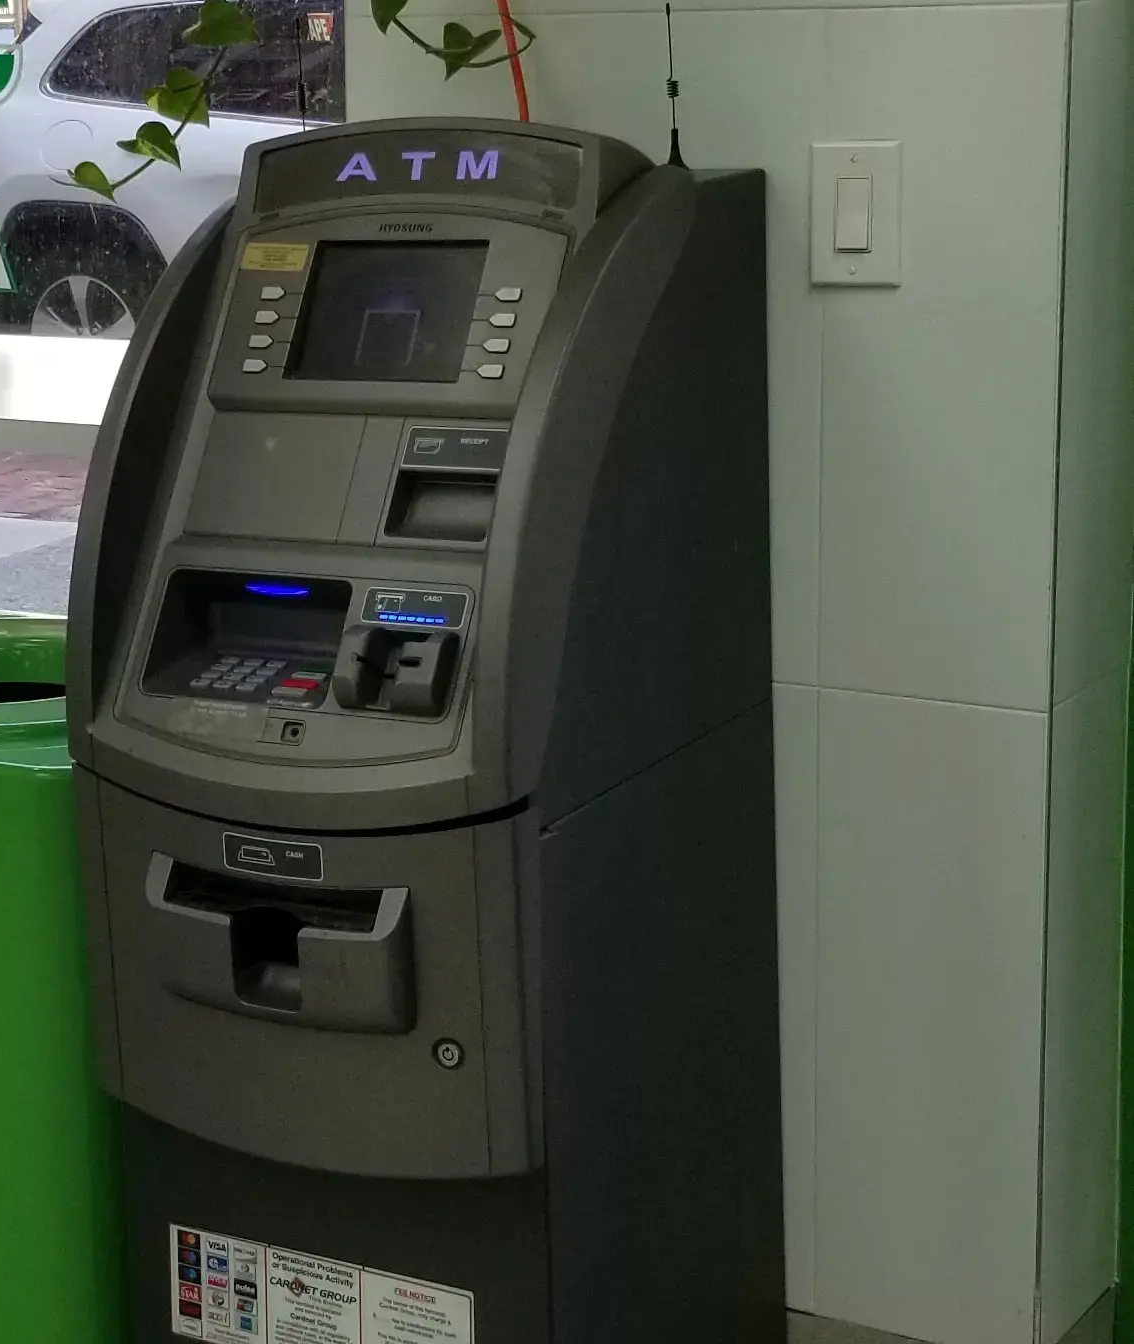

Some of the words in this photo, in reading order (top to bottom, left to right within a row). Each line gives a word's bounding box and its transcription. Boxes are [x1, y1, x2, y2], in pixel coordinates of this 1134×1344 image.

[335, 149, 499, 182] ATM
[378, 222, 434, 234] HYOSUNG
[285, 850, 304, 860] CASH
[207, 1239, 227, 1253] VISA
[272, 1251, 316, 1269] Operational
[317, 1262, 354, 1279] Problems
[325, 1274, 354, 1290] Activity
[319, 1288, 358, 1305] GROUP
